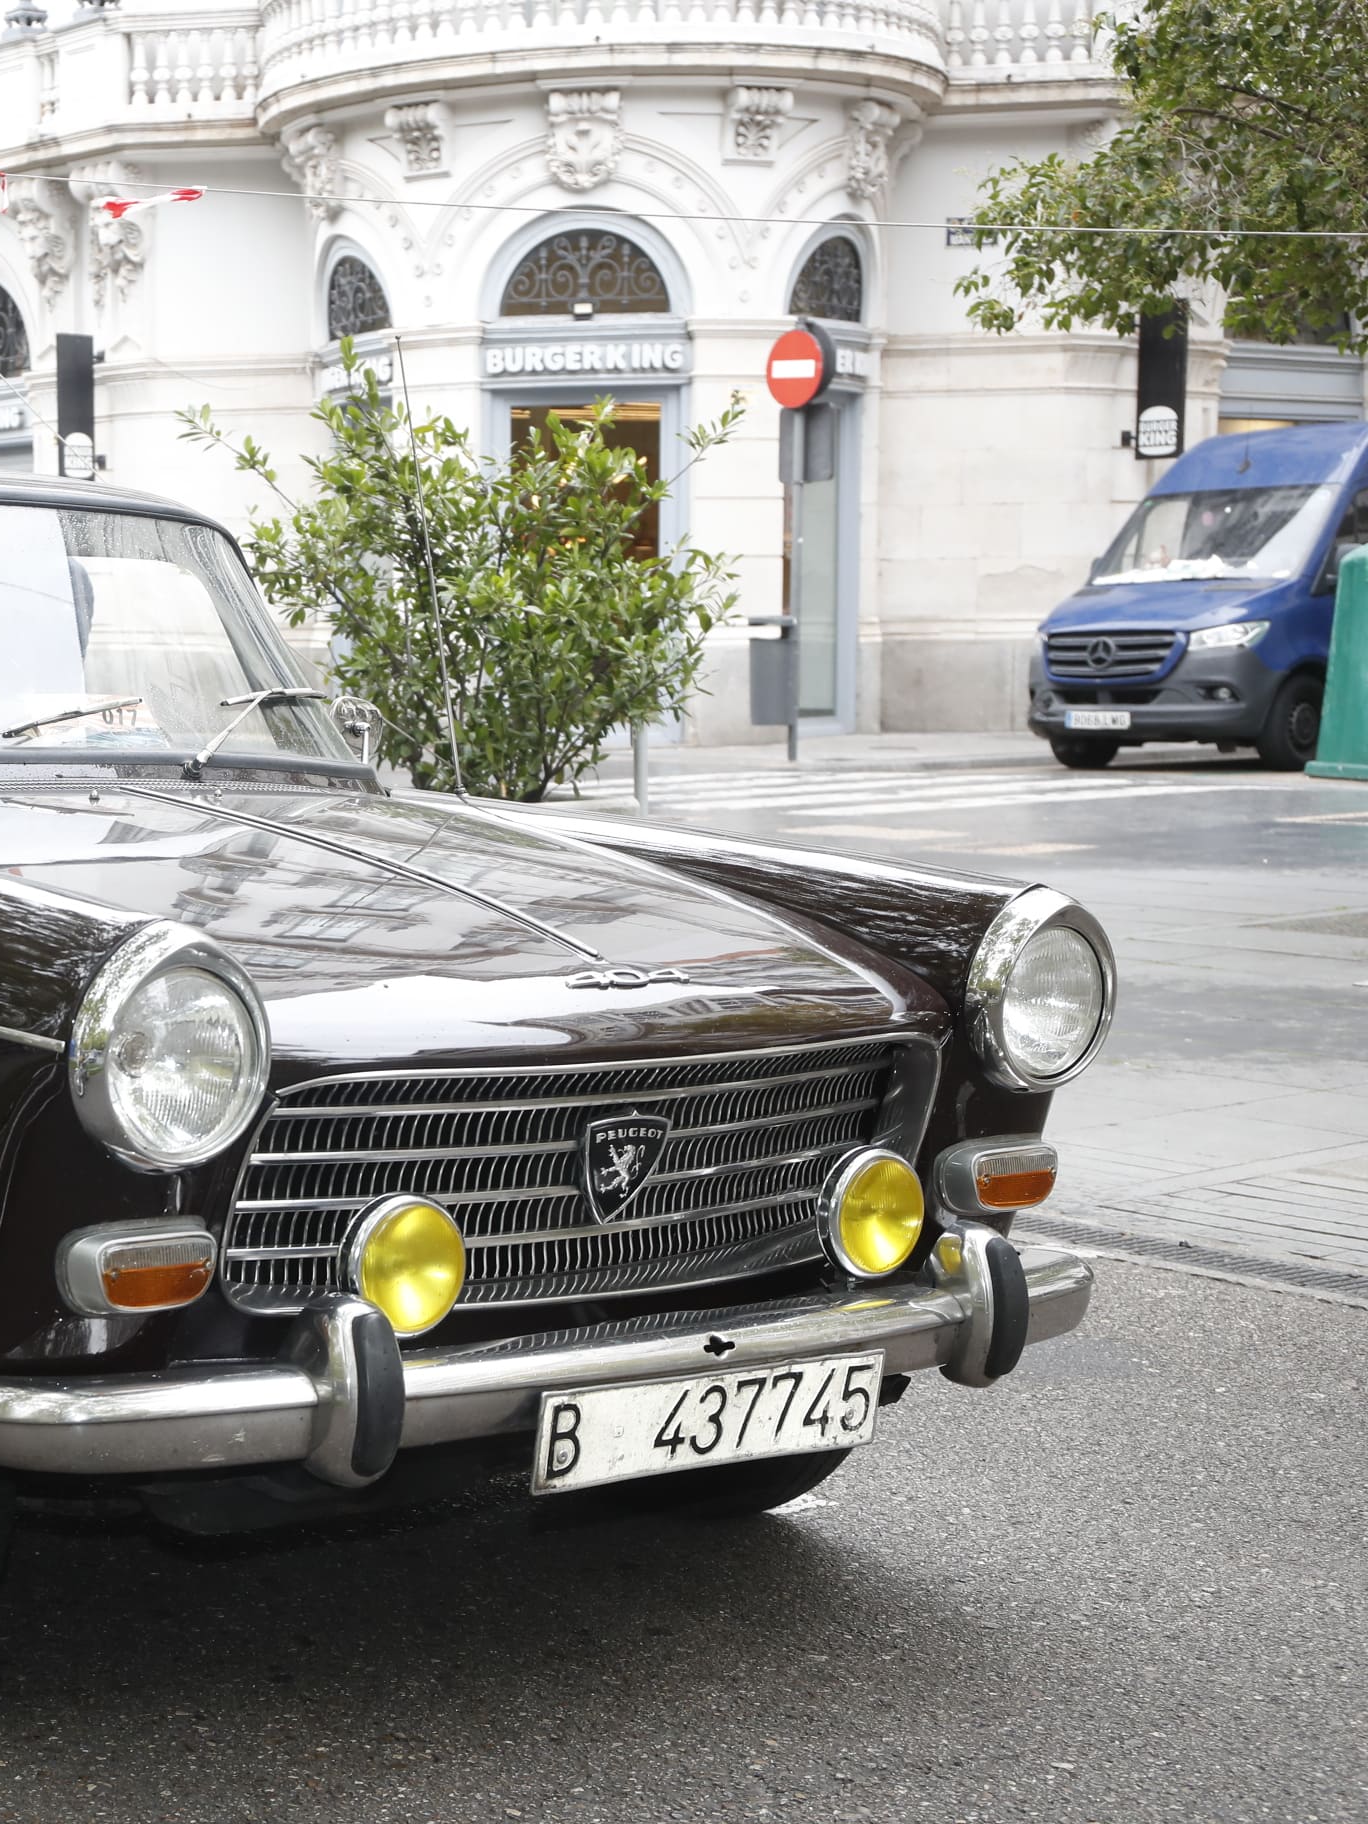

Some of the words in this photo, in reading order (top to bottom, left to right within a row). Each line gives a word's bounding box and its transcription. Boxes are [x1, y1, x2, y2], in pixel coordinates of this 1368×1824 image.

[486, 345, 602, 374] BURGER
[606, 343, 685, 370] KING
[1139, 430, 1178, 446] KING
[103, 708, 137, 726] 017
[566, 968, 690, 990] 404
[595, 1127, 665, 1144] PEUGEOT
[545, 1403, 582, 1480] B
[653, 1364, 875, 1458] 4377745
